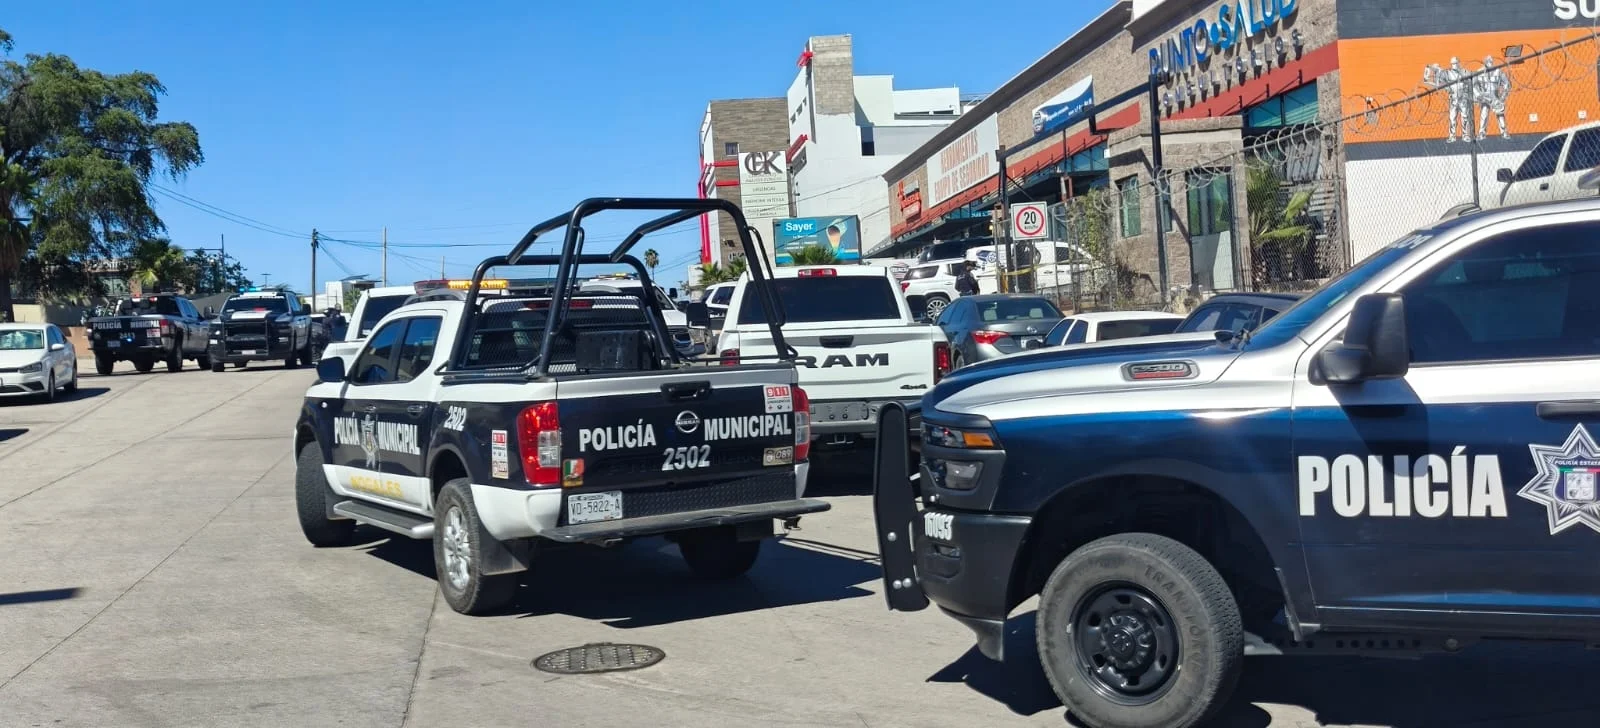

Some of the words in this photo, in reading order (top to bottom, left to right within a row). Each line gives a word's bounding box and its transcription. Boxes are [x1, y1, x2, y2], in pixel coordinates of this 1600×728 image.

[1149, 19, 1209, 75] PUNTO
[1161, 28, 1305, 109] ONSULTORIOS
[785, 222, 813, 232] Sayer
[1024, 211, 1036, 225] 20
[795, 352, 890, 369] RAM
[767, 387, 789, 397] 911
[443, 405, 467, 432] 2502
[334, 411, 361, 446] POLICÍA
[377, 421, 421, 456] MUNICIPAL
[579, 418, 657, 452] POLICÍA
[703, 413, 793, 441] MUNICIPAL
[661, 444, 711, 471] 2502
[351, 475, 404, 499] NOGALES
[1298, 445, 1508, 518] POLICÍA
